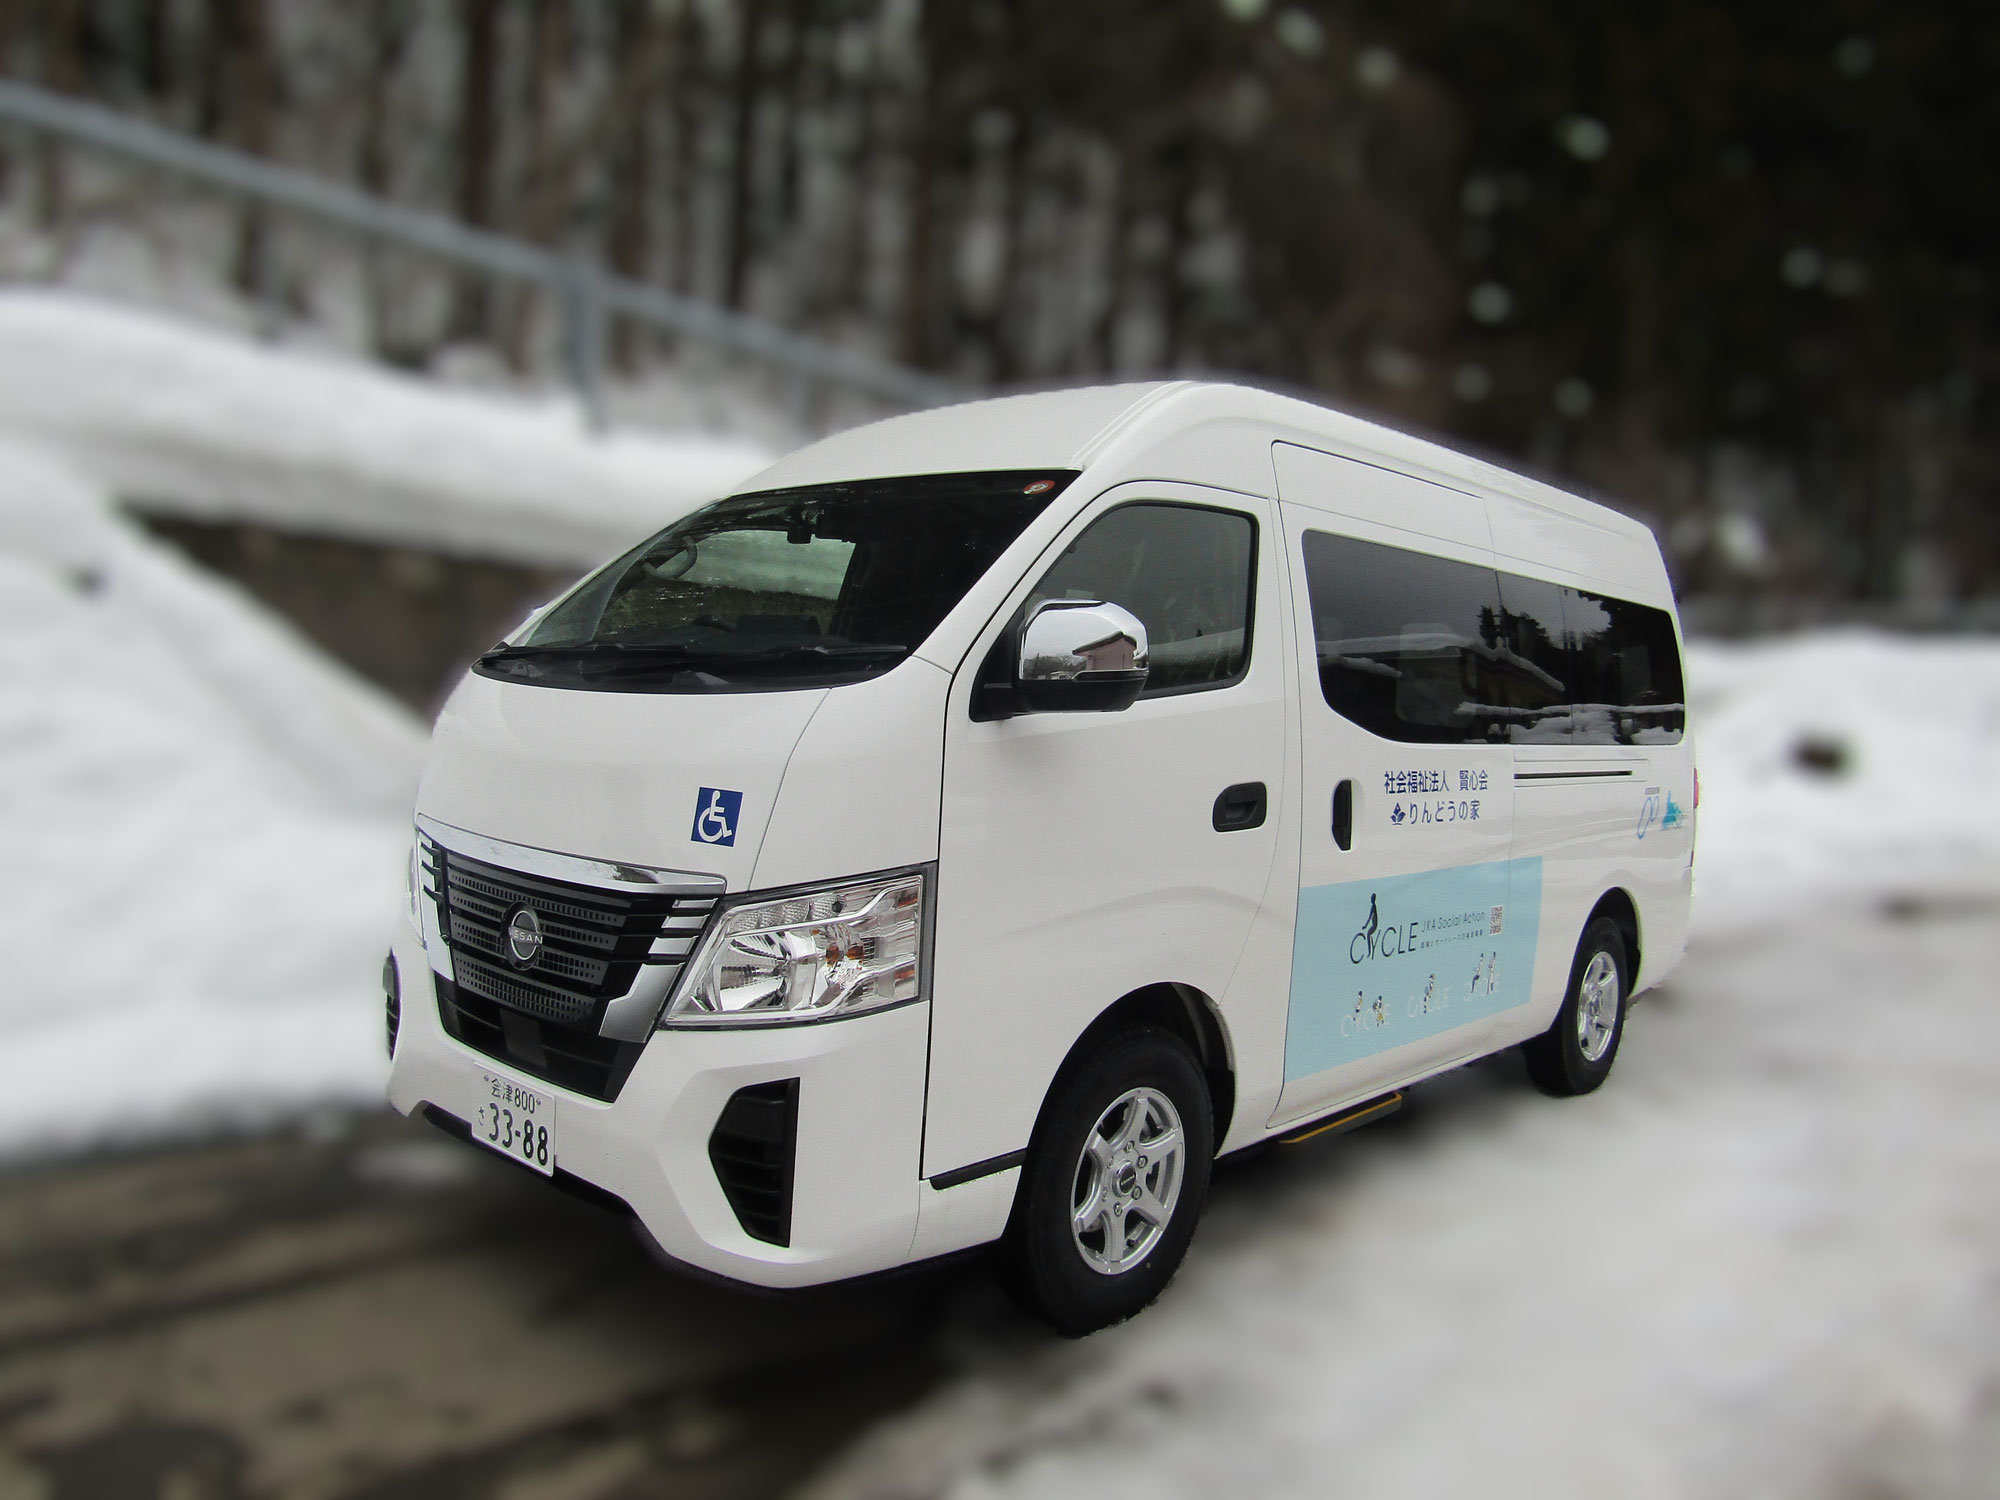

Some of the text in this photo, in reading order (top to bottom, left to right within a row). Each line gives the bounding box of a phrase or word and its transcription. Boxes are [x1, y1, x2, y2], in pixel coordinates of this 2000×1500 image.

[1384, 769, 1488, 794] 社会福祉法人 賢心会
[1409, 799, 1480, 824] りんどうの家
[1437, 914, 1461, 930] Social
[1463, 911, 1485, 925] Action
[508, 926, 543, 945] SSAN
[1350, 922, 1419, 965] CYCLE
[1341, 1003, 1390, 1037] CYCE
[489, 1102, 548, 1166] 33-88
